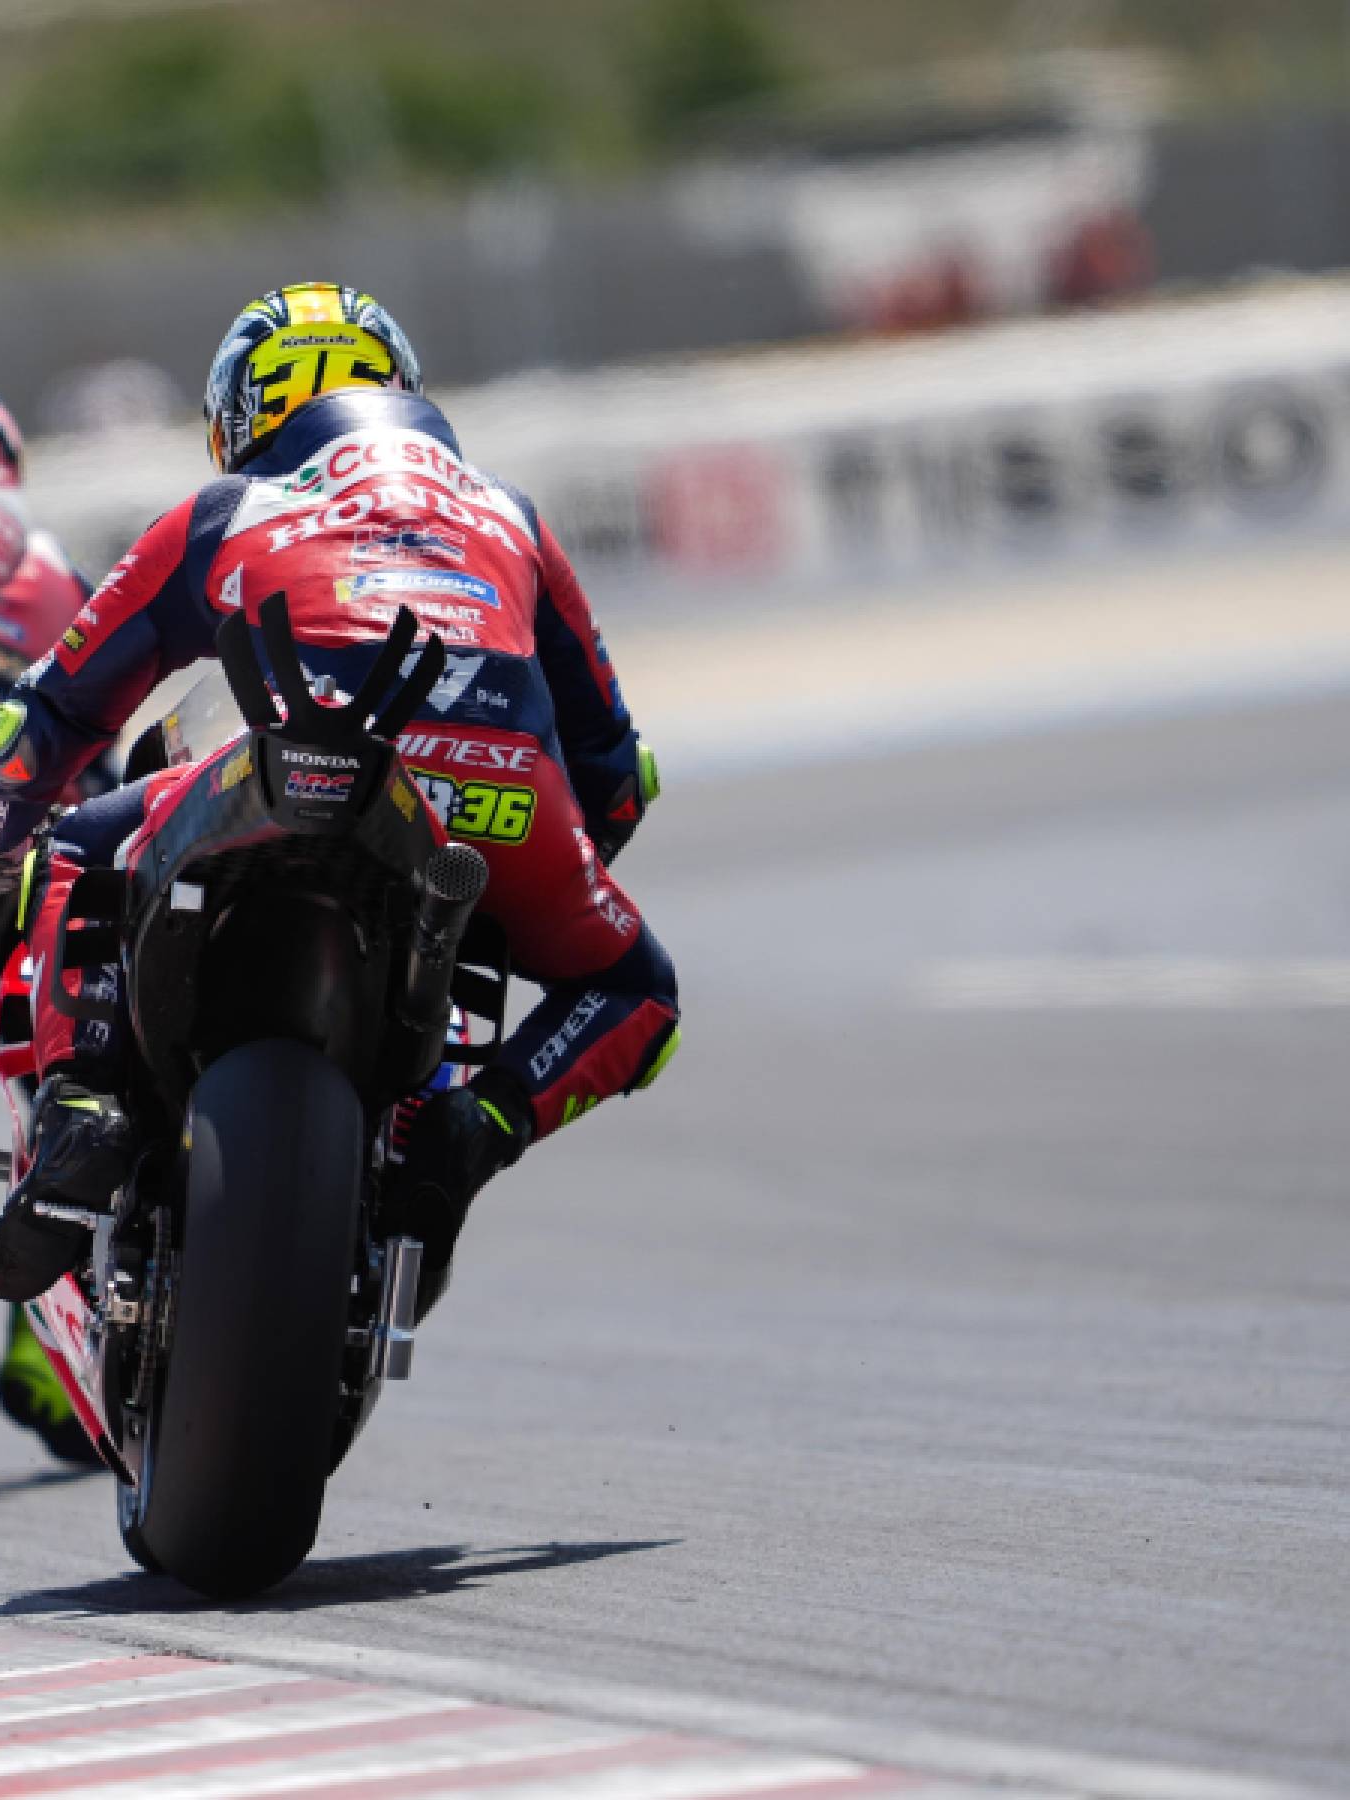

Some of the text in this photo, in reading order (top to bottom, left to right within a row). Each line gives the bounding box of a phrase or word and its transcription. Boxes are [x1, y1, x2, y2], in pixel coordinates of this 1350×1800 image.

[267, 485, 523, 556] HONDA
[281, 749, 361, 769] HONDA
[395, 734, 538, 772] INESE
